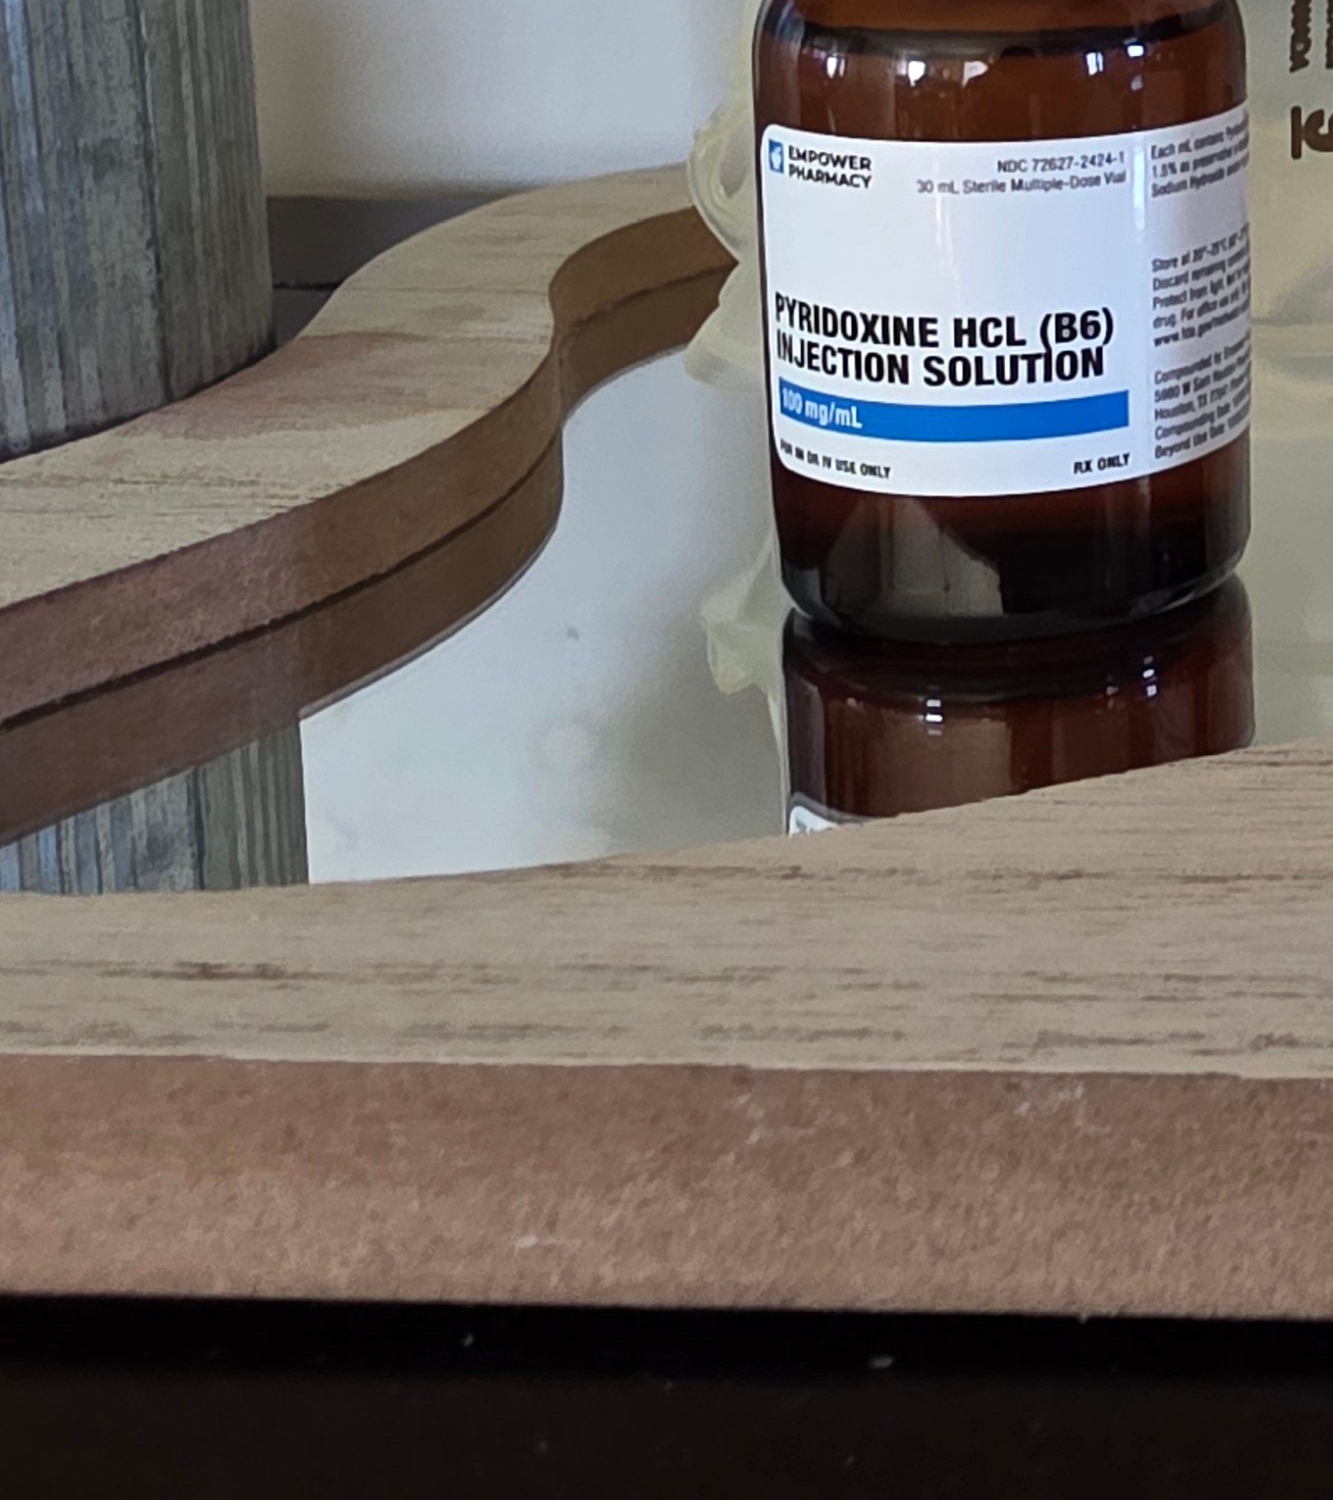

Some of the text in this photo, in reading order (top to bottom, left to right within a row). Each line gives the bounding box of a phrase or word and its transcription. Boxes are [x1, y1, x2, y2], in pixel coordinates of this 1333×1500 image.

[788, 146, 873, 171] EMPOWER
[997, 159, 1027, 174] NDC
[788, 164, 873, 189] PHARMACY
[962, 179, 1006, 195] Sterile
[1011, 173, 1101, 193] Multiple-Dose
[1104, 171, 1127, 185] Vial
[775, 290, 1114, 352] PYRIDOXINE HCL (B6)
[776, 328, 1105, 387] INJECTION SOLUTION
[804, 396, 863, 429] mg/mL
[835, 455, 892, 479] USE ONLY
[1073, 453, 1131, 475] RX ONLY
